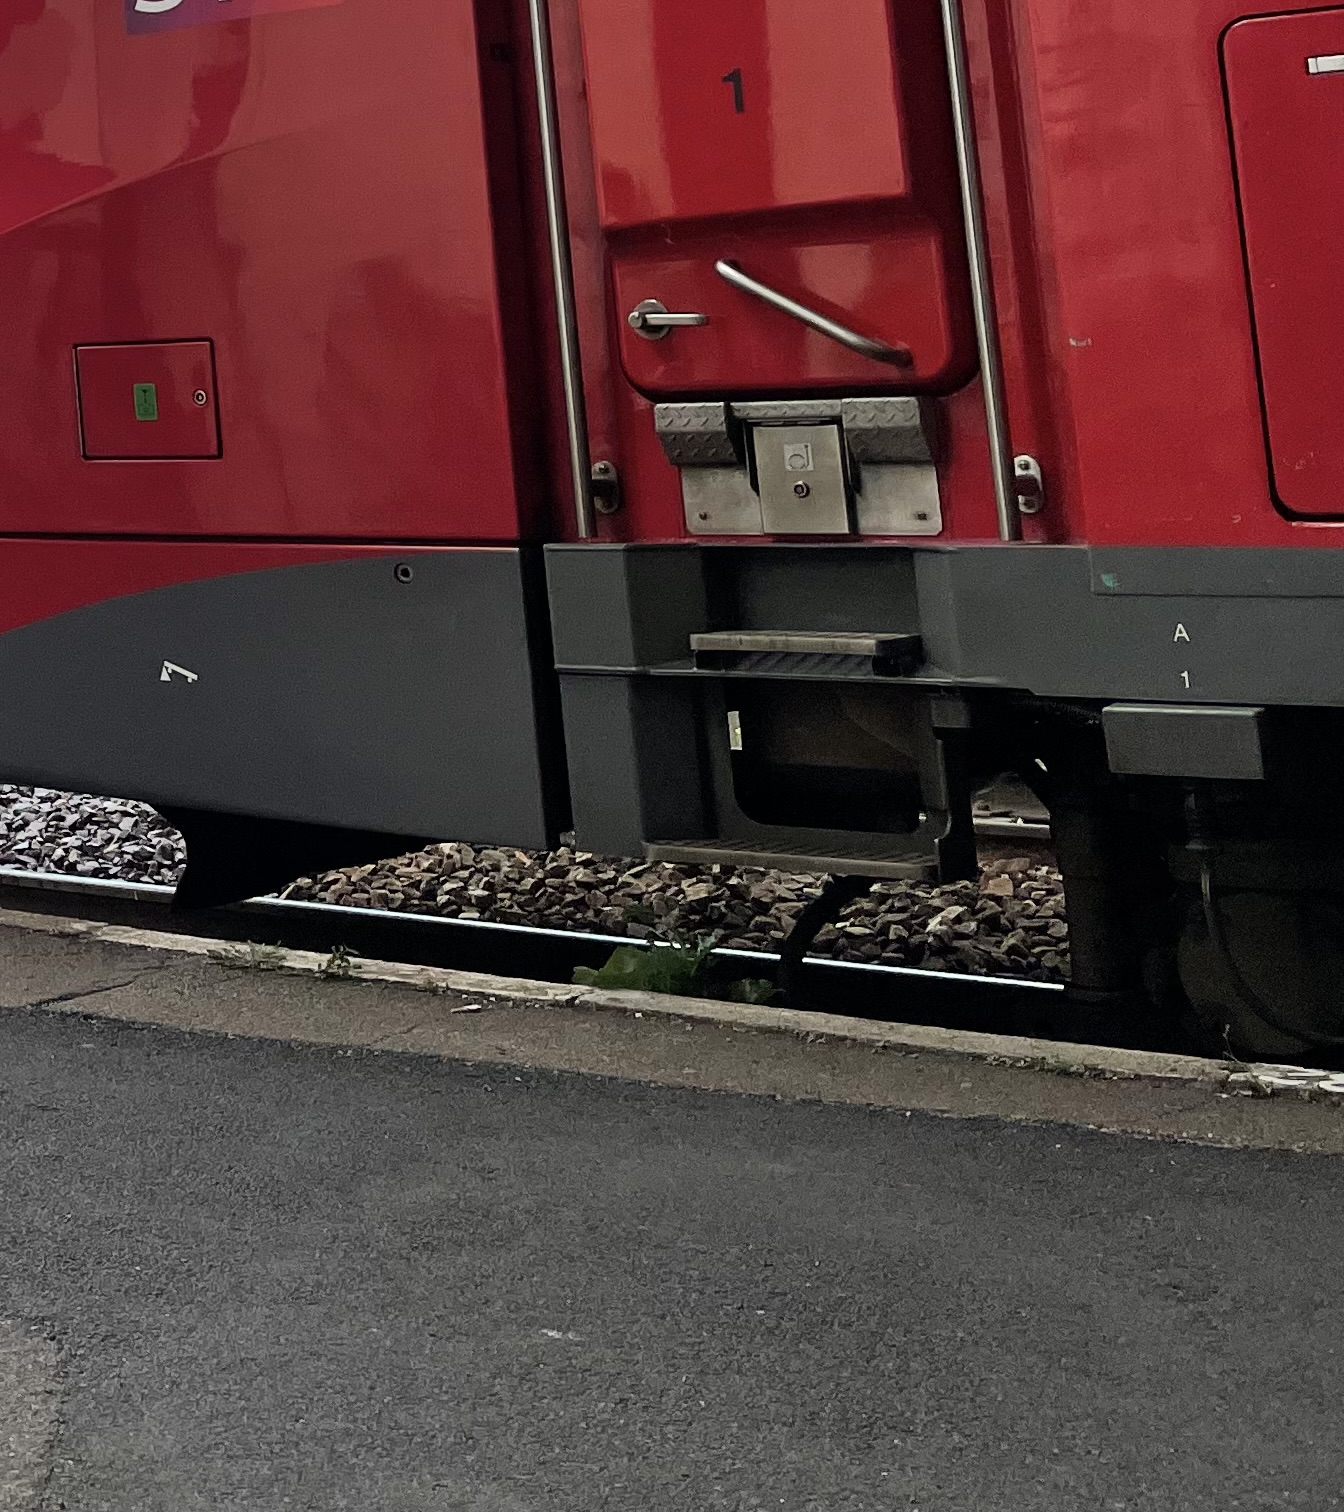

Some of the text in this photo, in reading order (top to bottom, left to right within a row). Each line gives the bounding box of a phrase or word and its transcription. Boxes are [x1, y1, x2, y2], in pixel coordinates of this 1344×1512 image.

[721, 67, 744, 113] 1
[1173, 623, 1191, 642] A
[1180, 670, 1190, 689] 1
